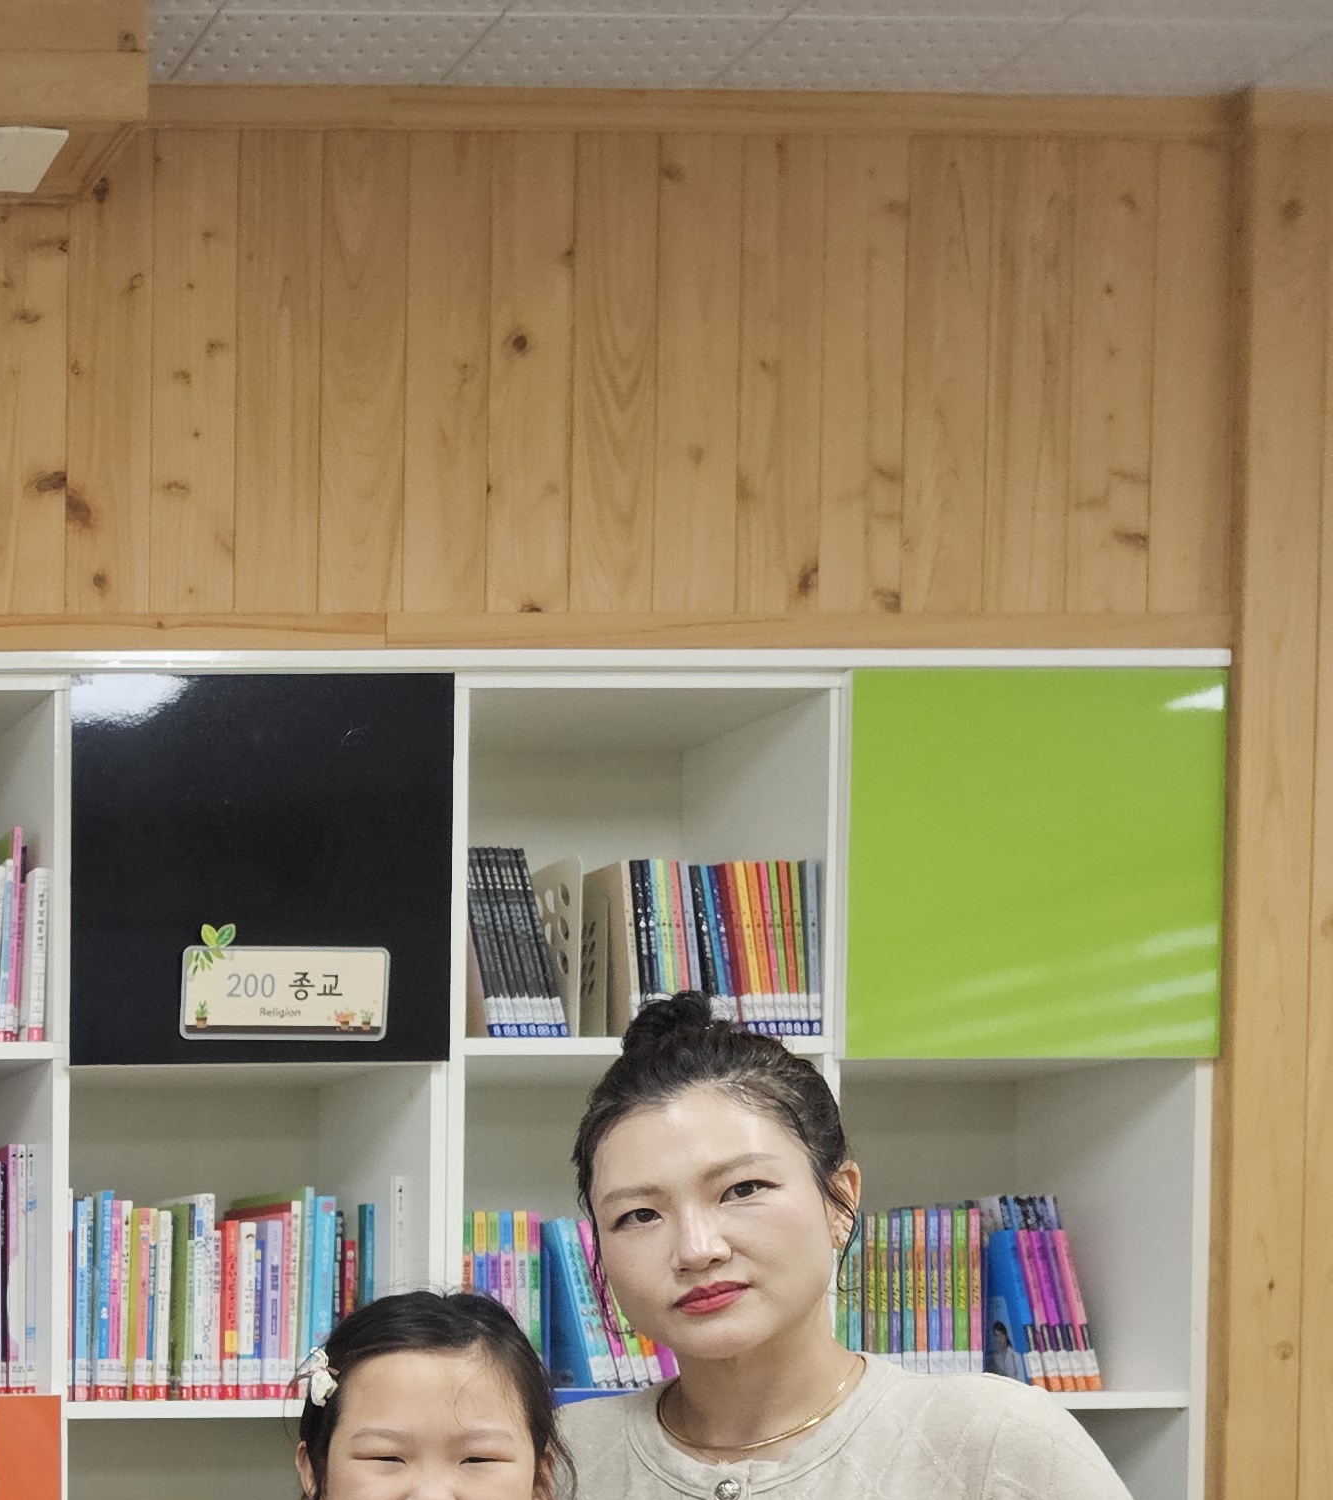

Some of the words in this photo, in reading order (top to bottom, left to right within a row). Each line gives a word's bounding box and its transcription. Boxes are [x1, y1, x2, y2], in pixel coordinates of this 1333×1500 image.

[226, 972, 275, 998] 200
[288, 971, 343, 1001] 종교
[259, 1006, 302, 1019] Religion
